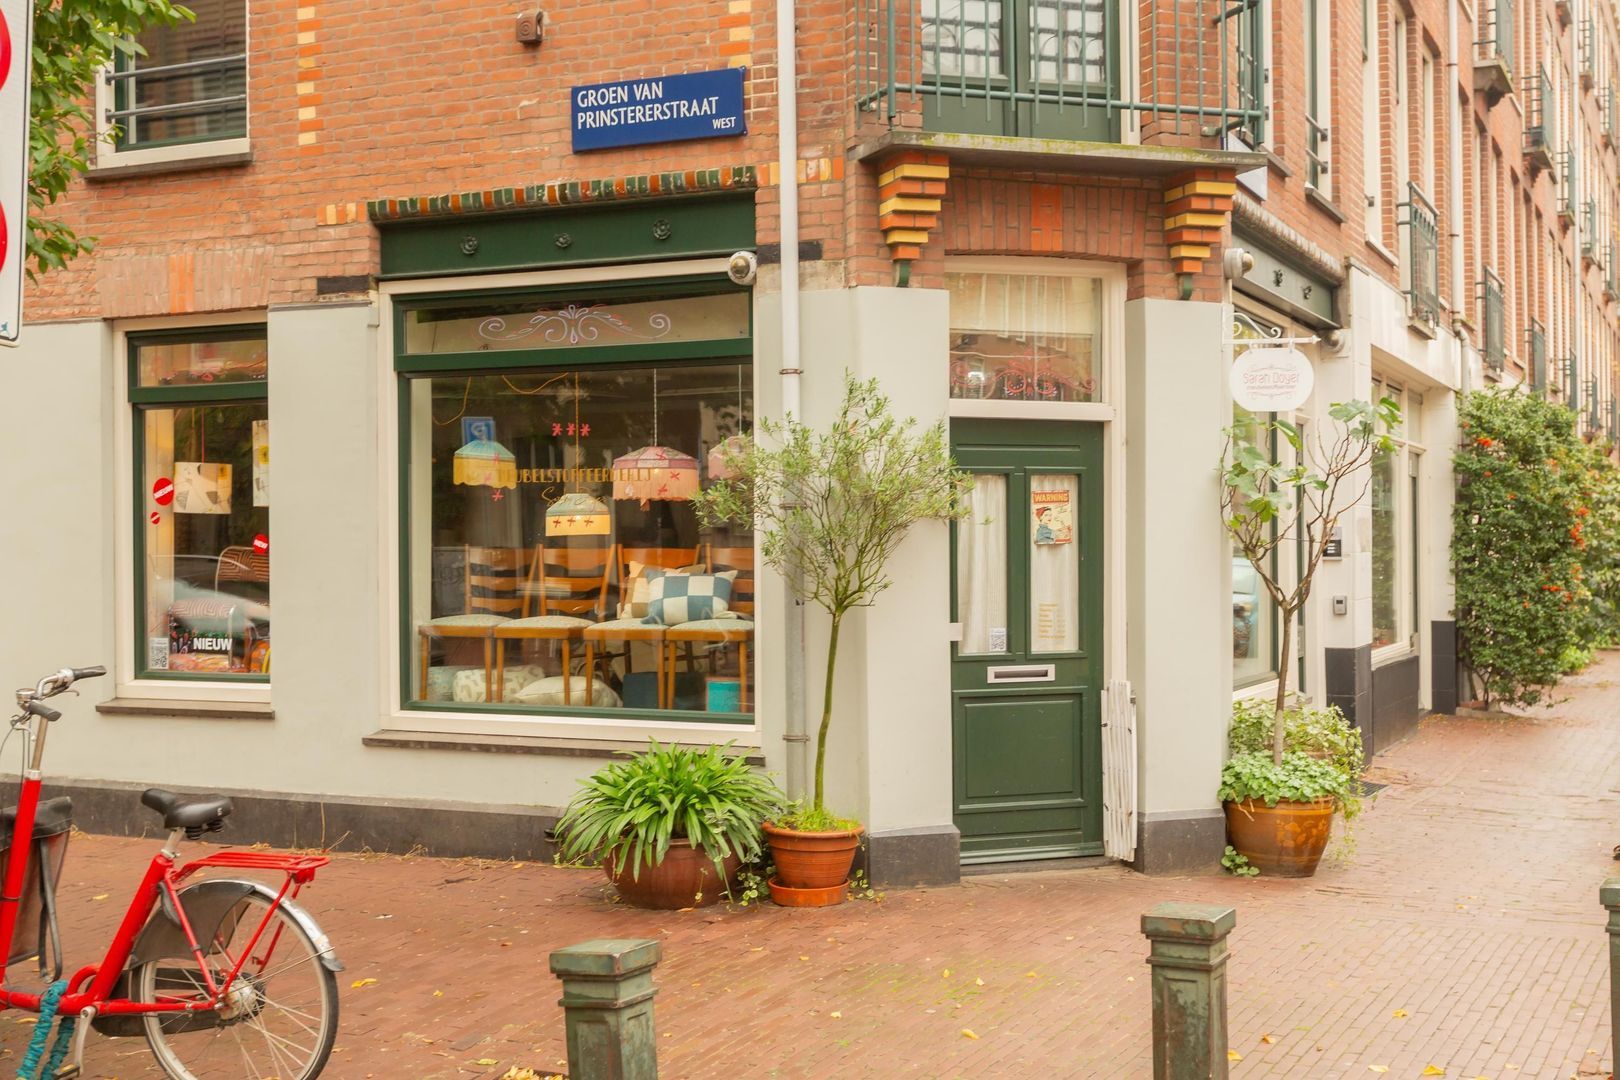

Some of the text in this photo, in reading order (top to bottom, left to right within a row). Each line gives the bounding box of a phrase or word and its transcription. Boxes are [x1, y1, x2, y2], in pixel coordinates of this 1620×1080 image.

[577, 81, 663, 108] GROEN VAN
[577, 96, 719, 130] PRINSTERERSTRAAT
[712, 116, 737, 129] WEST
[1034, 493, 1068, 503] WARNING
[193, 638, 232, 650] NIEUW
